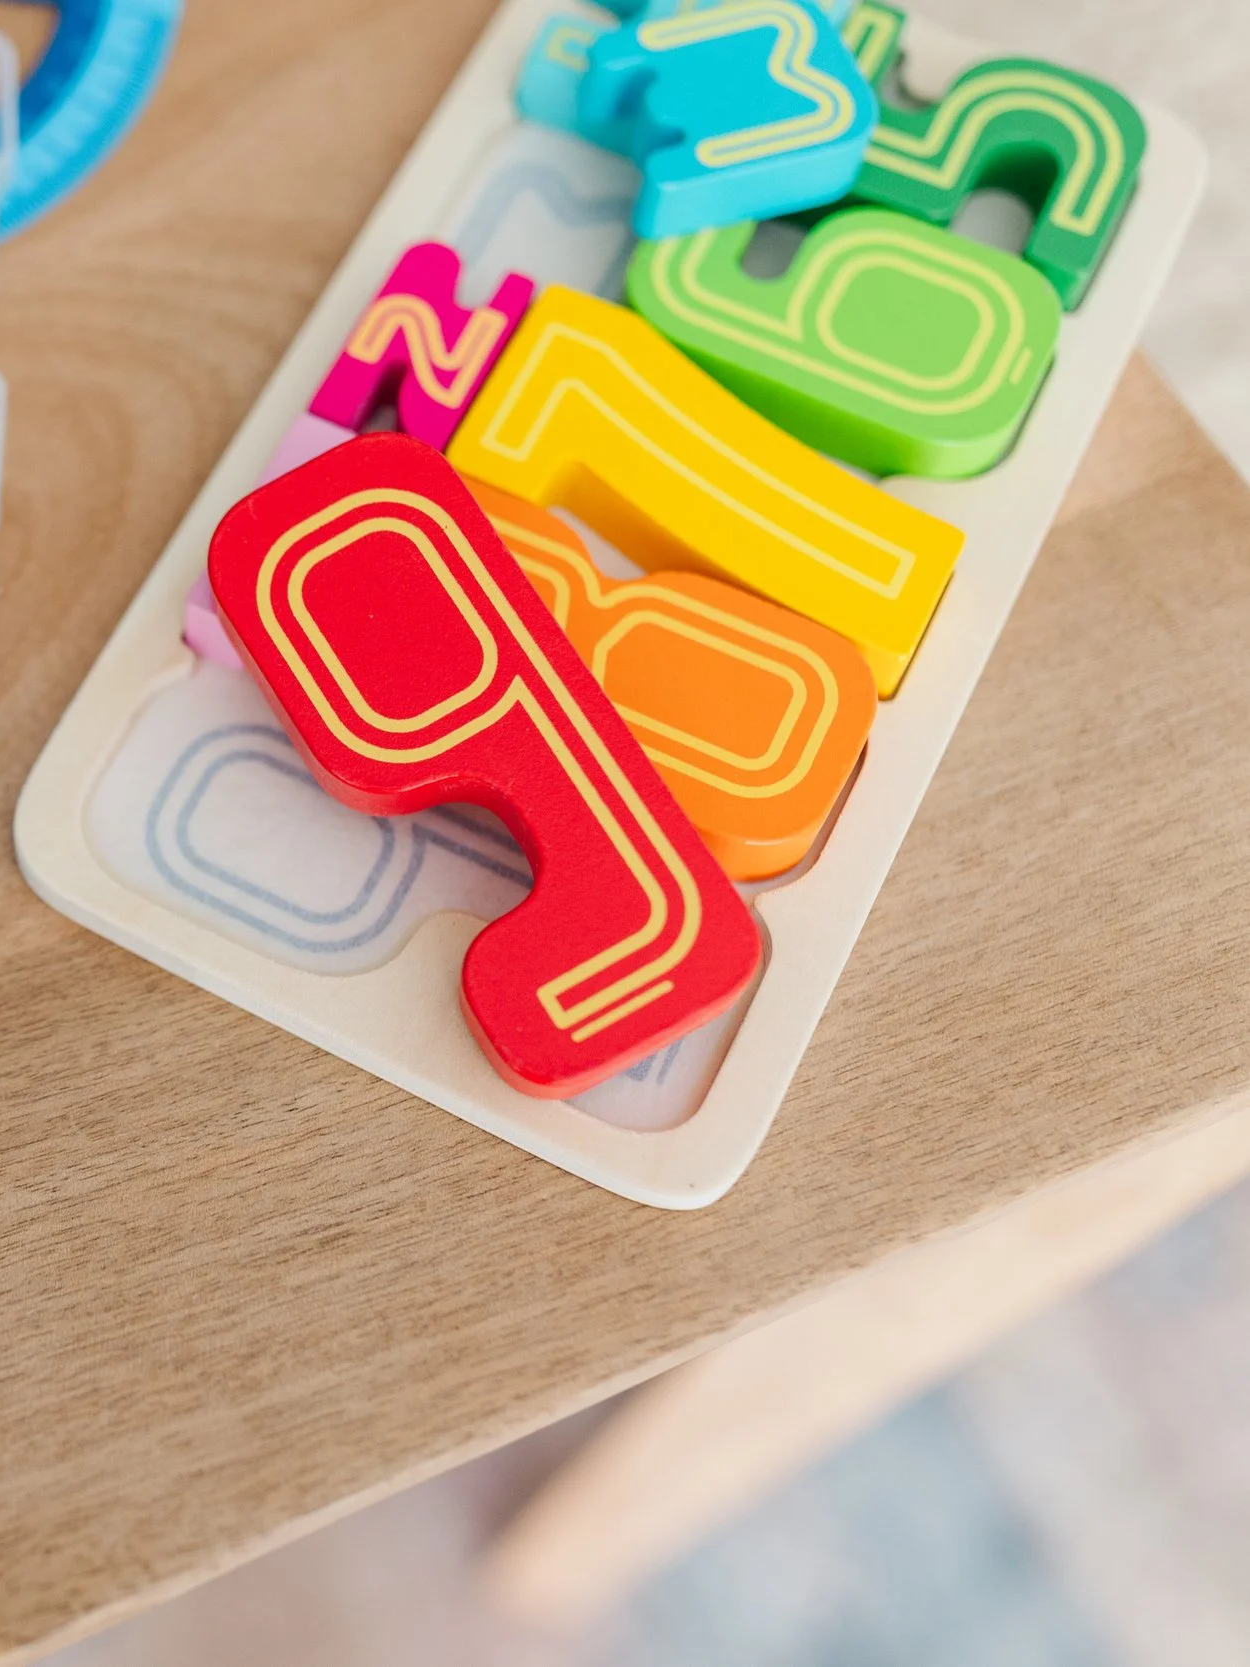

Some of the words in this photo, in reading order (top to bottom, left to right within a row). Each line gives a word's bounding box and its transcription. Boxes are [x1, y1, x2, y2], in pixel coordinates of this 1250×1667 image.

[610, 0, 874, 190] 3
[845, 0, 1146, 272] 5
[327, 266, 522, 428] 2
[628, 208, 1060, 442] 6
[447, 286, 964, 652] 7
[210, 434, 758, 1088] 9
[472, 480, 876, 842] 8
